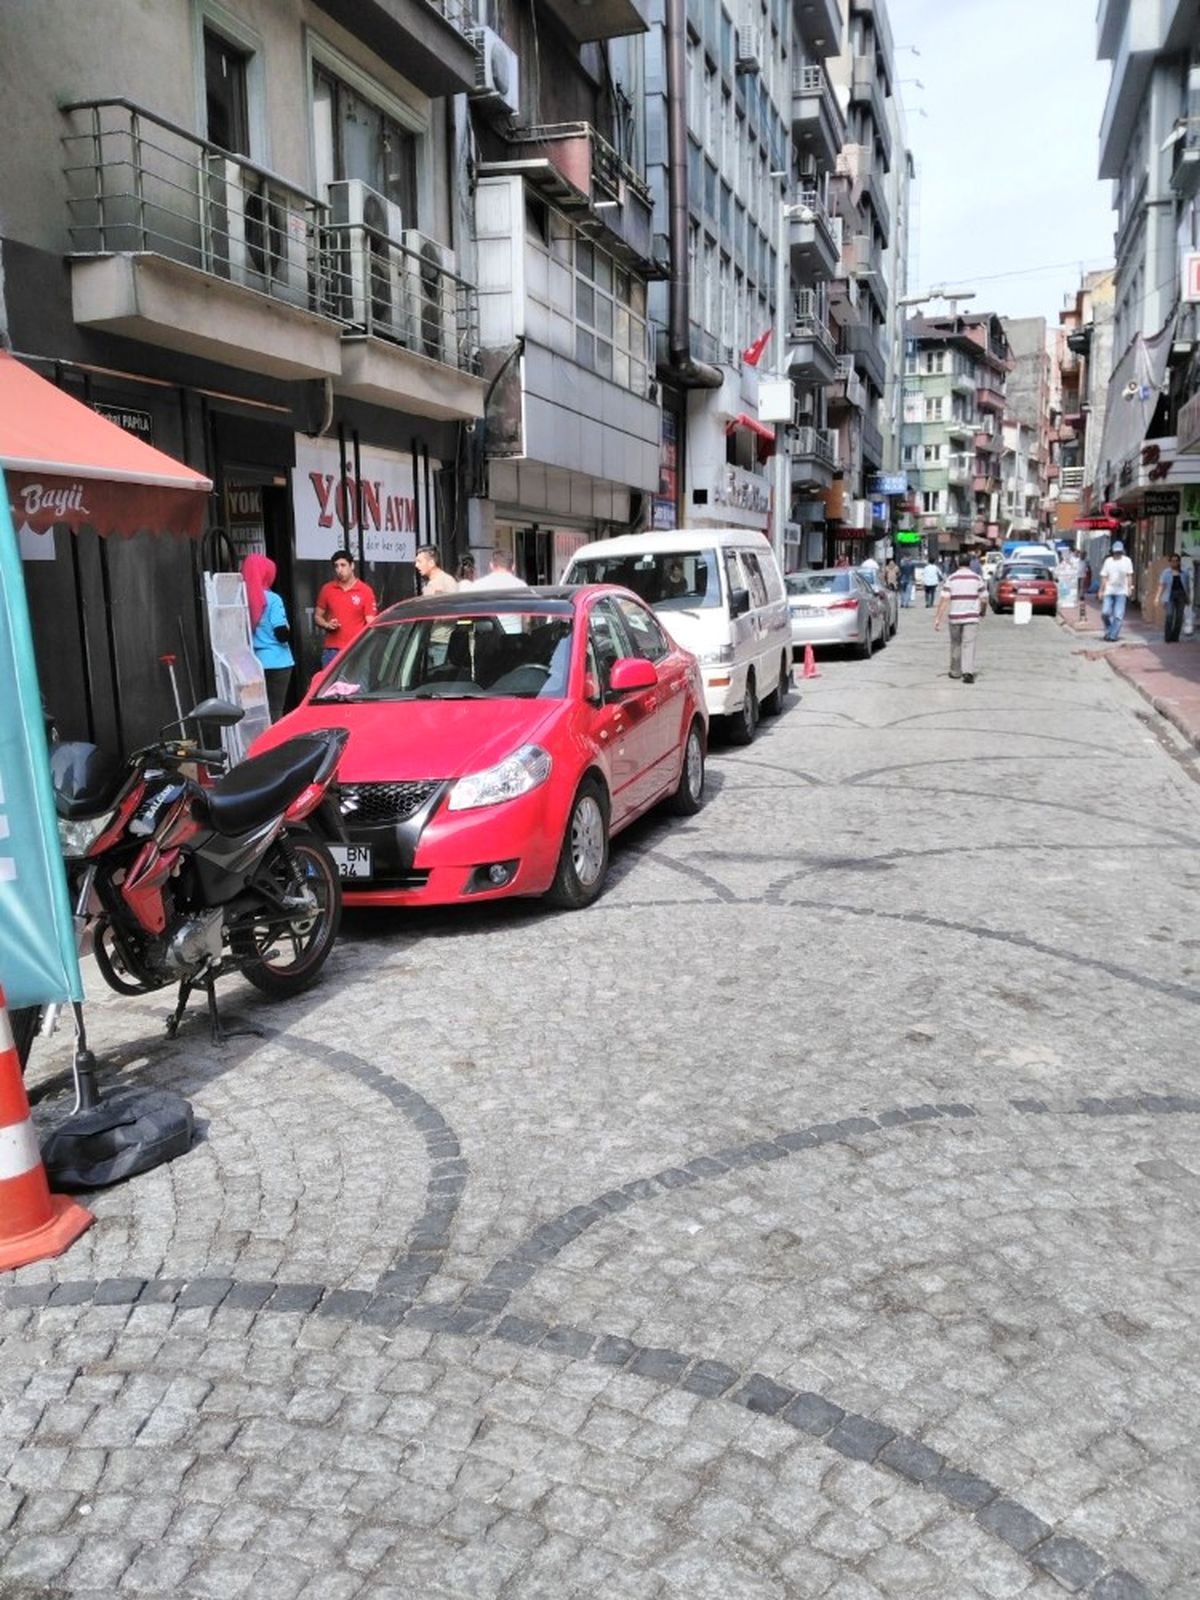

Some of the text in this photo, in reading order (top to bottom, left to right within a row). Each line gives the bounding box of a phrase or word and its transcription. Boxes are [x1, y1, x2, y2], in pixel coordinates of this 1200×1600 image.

[20, 483, 88, 517] Bayii
[228, 490, 260, 514] YOK
[385, 495, 416, 533] AVM
[347, 847, 368, 862] BN
